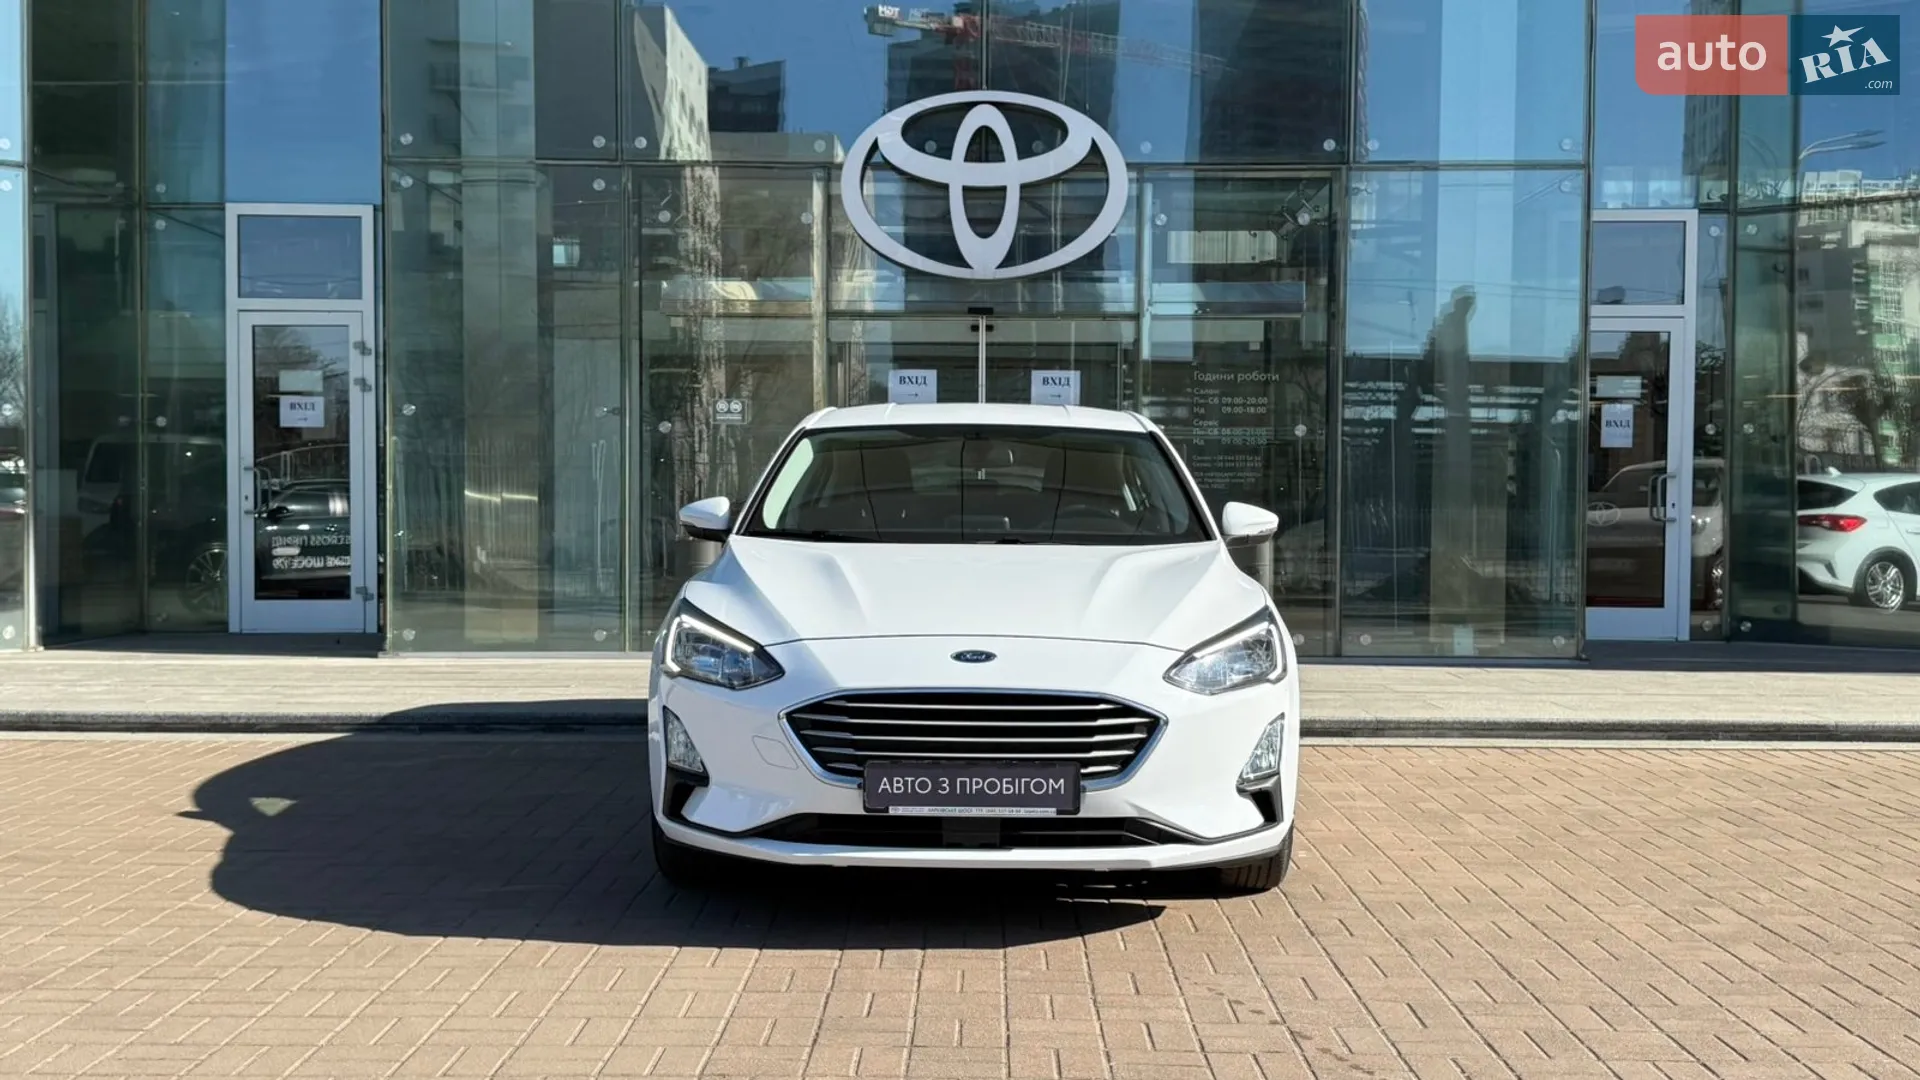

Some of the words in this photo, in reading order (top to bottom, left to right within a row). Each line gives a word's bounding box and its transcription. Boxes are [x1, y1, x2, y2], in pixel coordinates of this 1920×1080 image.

[899, 375, 928, 386] ВХІД
[1042, 376, 1071, 387] ВХІД
[1193, 370, 1235, 382] Години
[1237, 370, 1280, 383] роботи
[878, 777, 932, 794] АВТО
[956, 777, 1065, 795] ПРОБІГОМ
